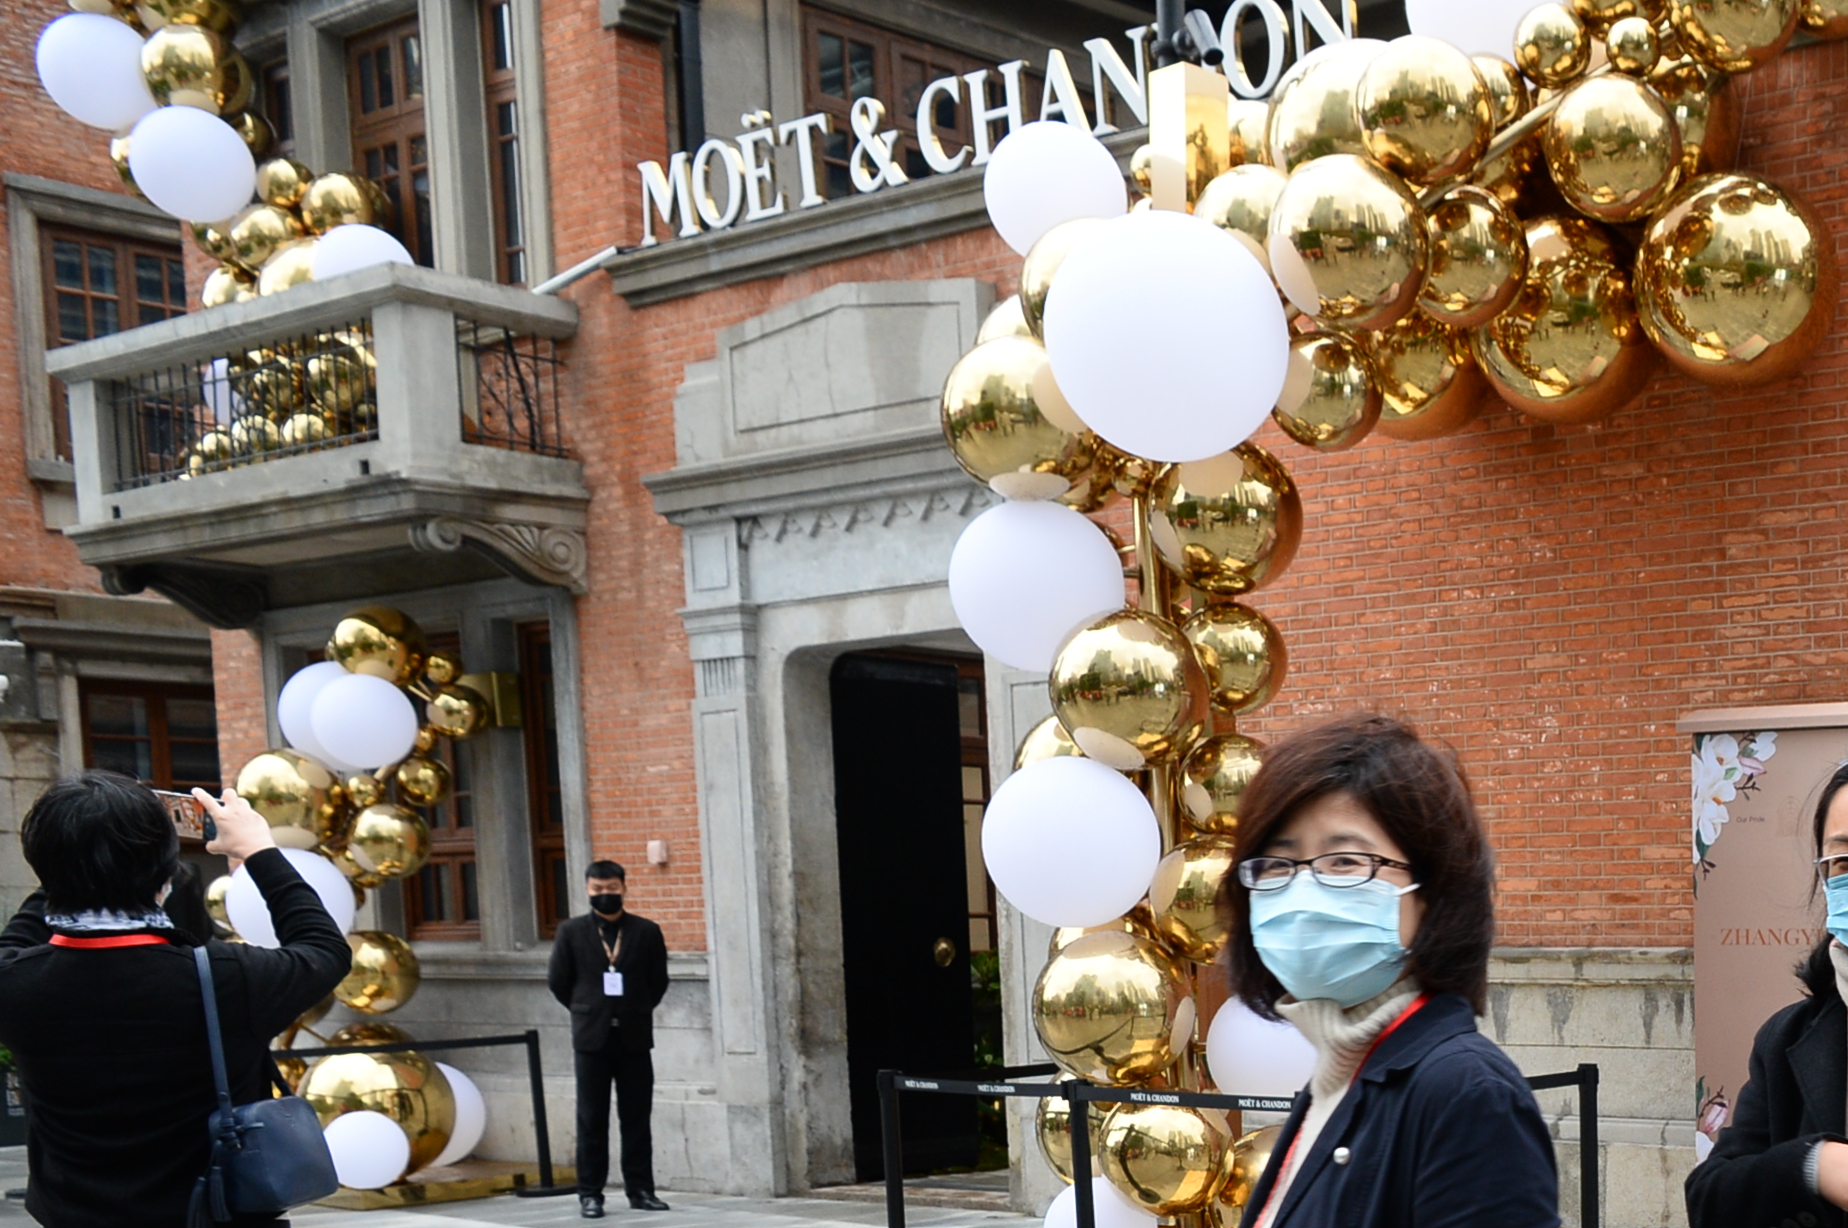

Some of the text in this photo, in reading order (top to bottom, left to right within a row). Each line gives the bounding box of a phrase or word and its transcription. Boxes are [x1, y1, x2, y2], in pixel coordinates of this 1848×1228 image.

[637, 0, 1358, 246] MOËT & CHANON
